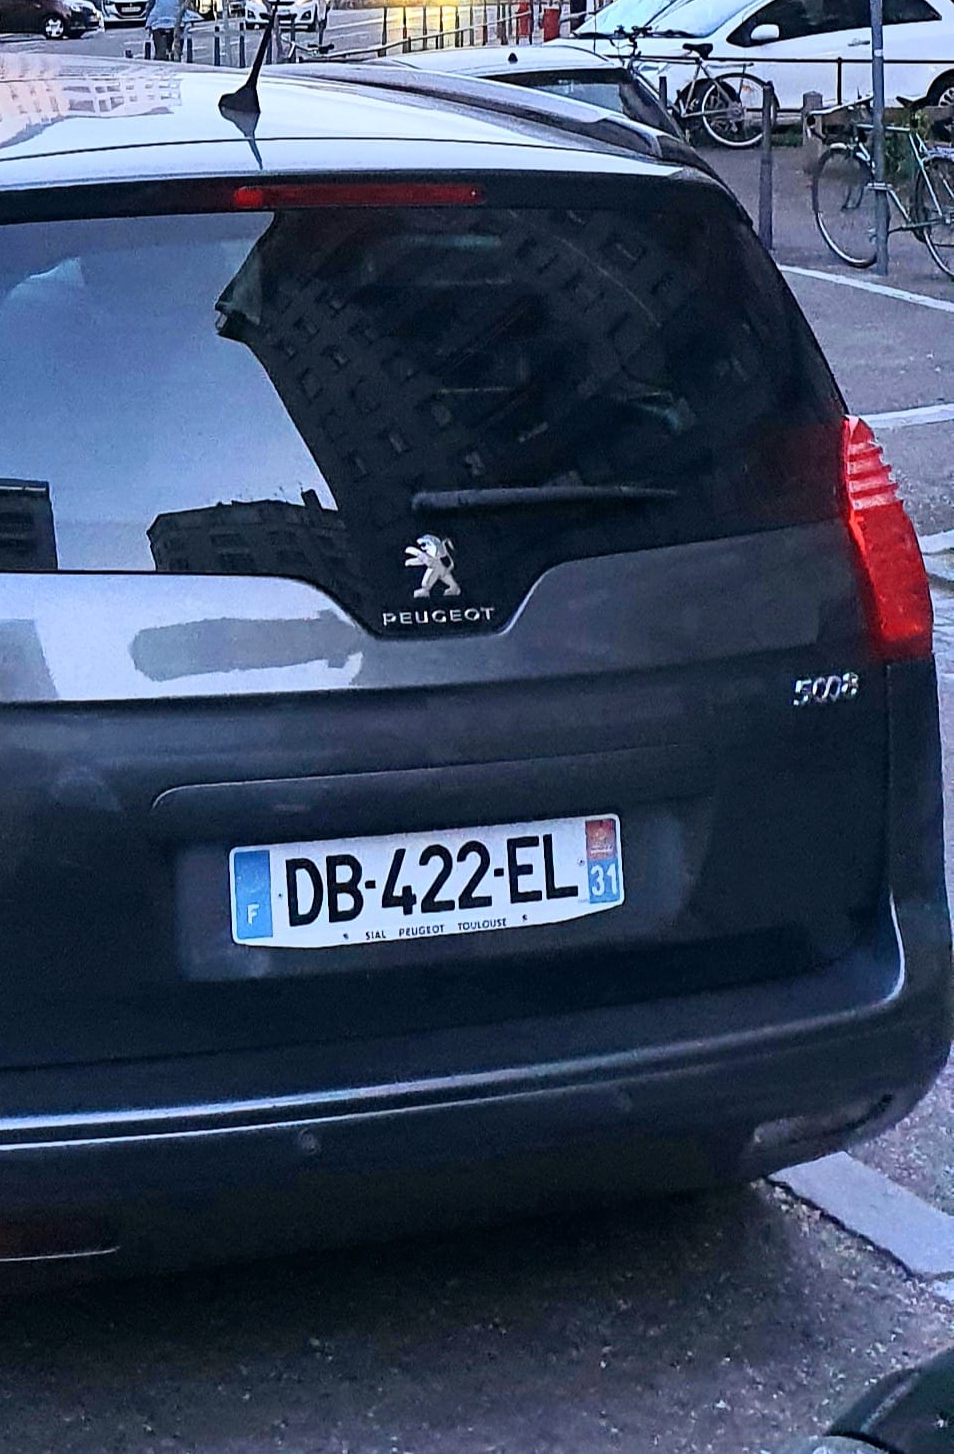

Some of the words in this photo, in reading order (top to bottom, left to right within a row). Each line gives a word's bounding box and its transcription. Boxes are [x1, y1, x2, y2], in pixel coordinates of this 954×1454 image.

[382, 606, 495, 626] PEUGEOT
[793, 671, 859, 706] 5008
[285, 833, 579, 927] DB-422-EL
[590, 861, 617, 896] 31
[246, 902, 261, 926] F
[365, 930, 387, 941] SIAL
[398, 924, 445, 938] PEUGEOT
[457, 917, 507, 931] TOULOUSE
